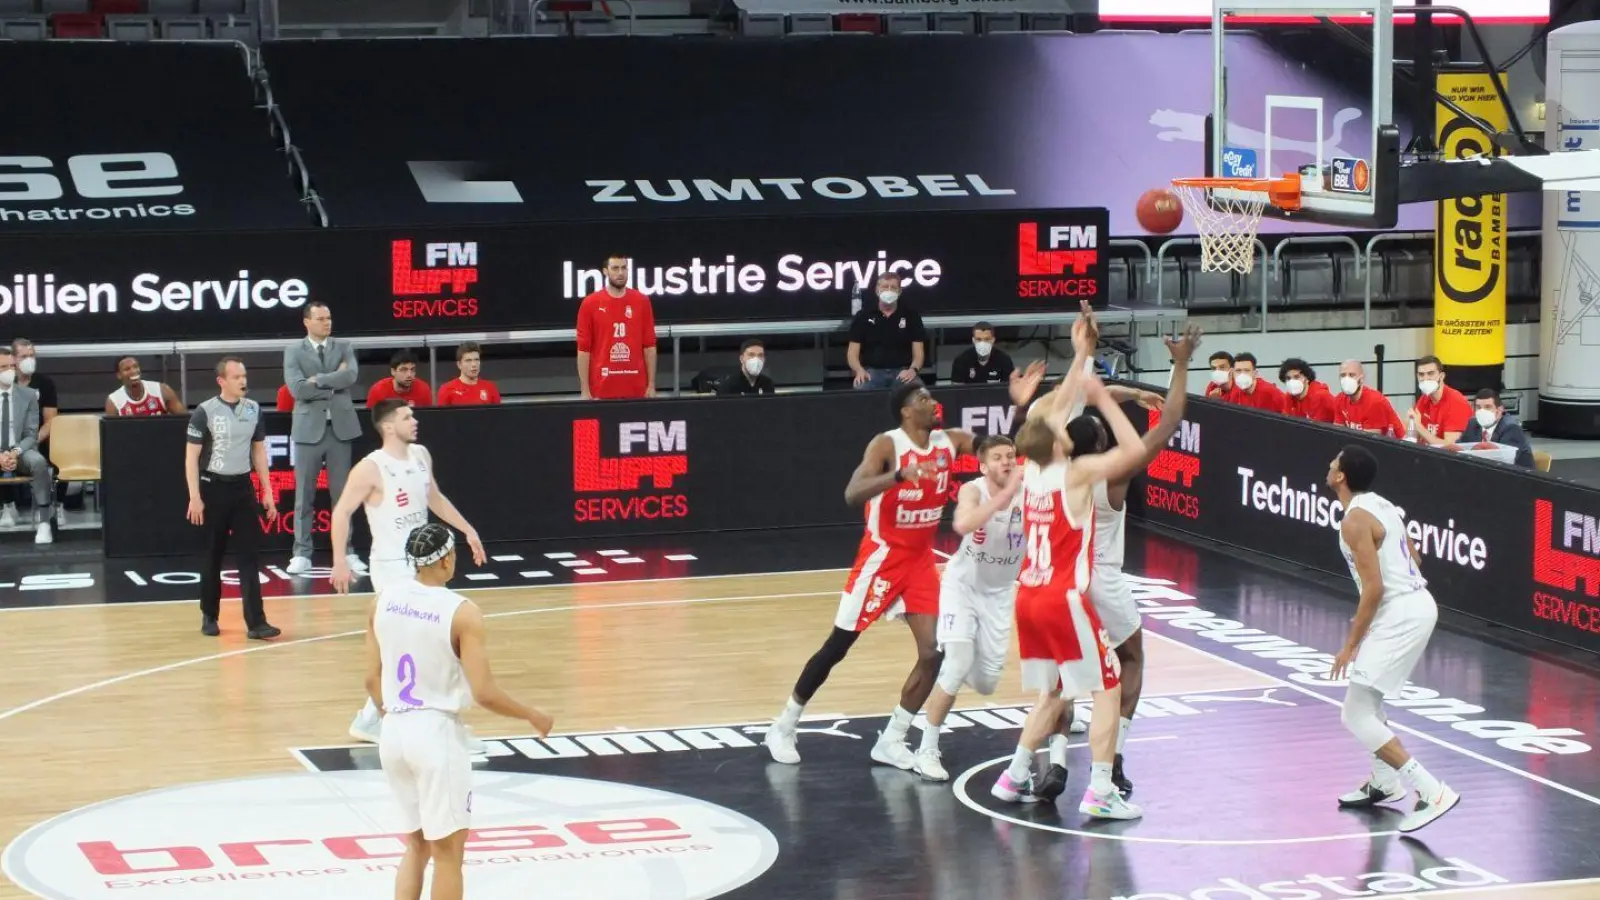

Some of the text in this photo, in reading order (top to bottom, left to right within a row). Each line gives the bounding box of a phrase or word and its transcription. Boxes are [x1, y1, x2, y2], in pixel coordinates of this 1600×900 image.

[585, 174, 1017, 203] ZUMTOBEL
[1334, 174, 1351, 188] BBL
[1050, 225, 1098, 249] FM
[426, 242, 478, 267] FM
[131, 270, 309, 313] Service
[1018, 279, 1097, 298] SERVICES
[392, 299, 479, 318] SERVICES
[613, 323, 626, 338] 20
[619, 420, 687, 454] FM
[574, 495, 688, 521] SERVICES
[1147, 484, 1199, 519] SERVICES
[1006, 531, 1023, 551] 17
[1394, 505, 1488, 571] ervice
[397, 653, 424, 706] 2
[78, 817, 692, 875] brose
[104, 866, 347, 889] Excellence
